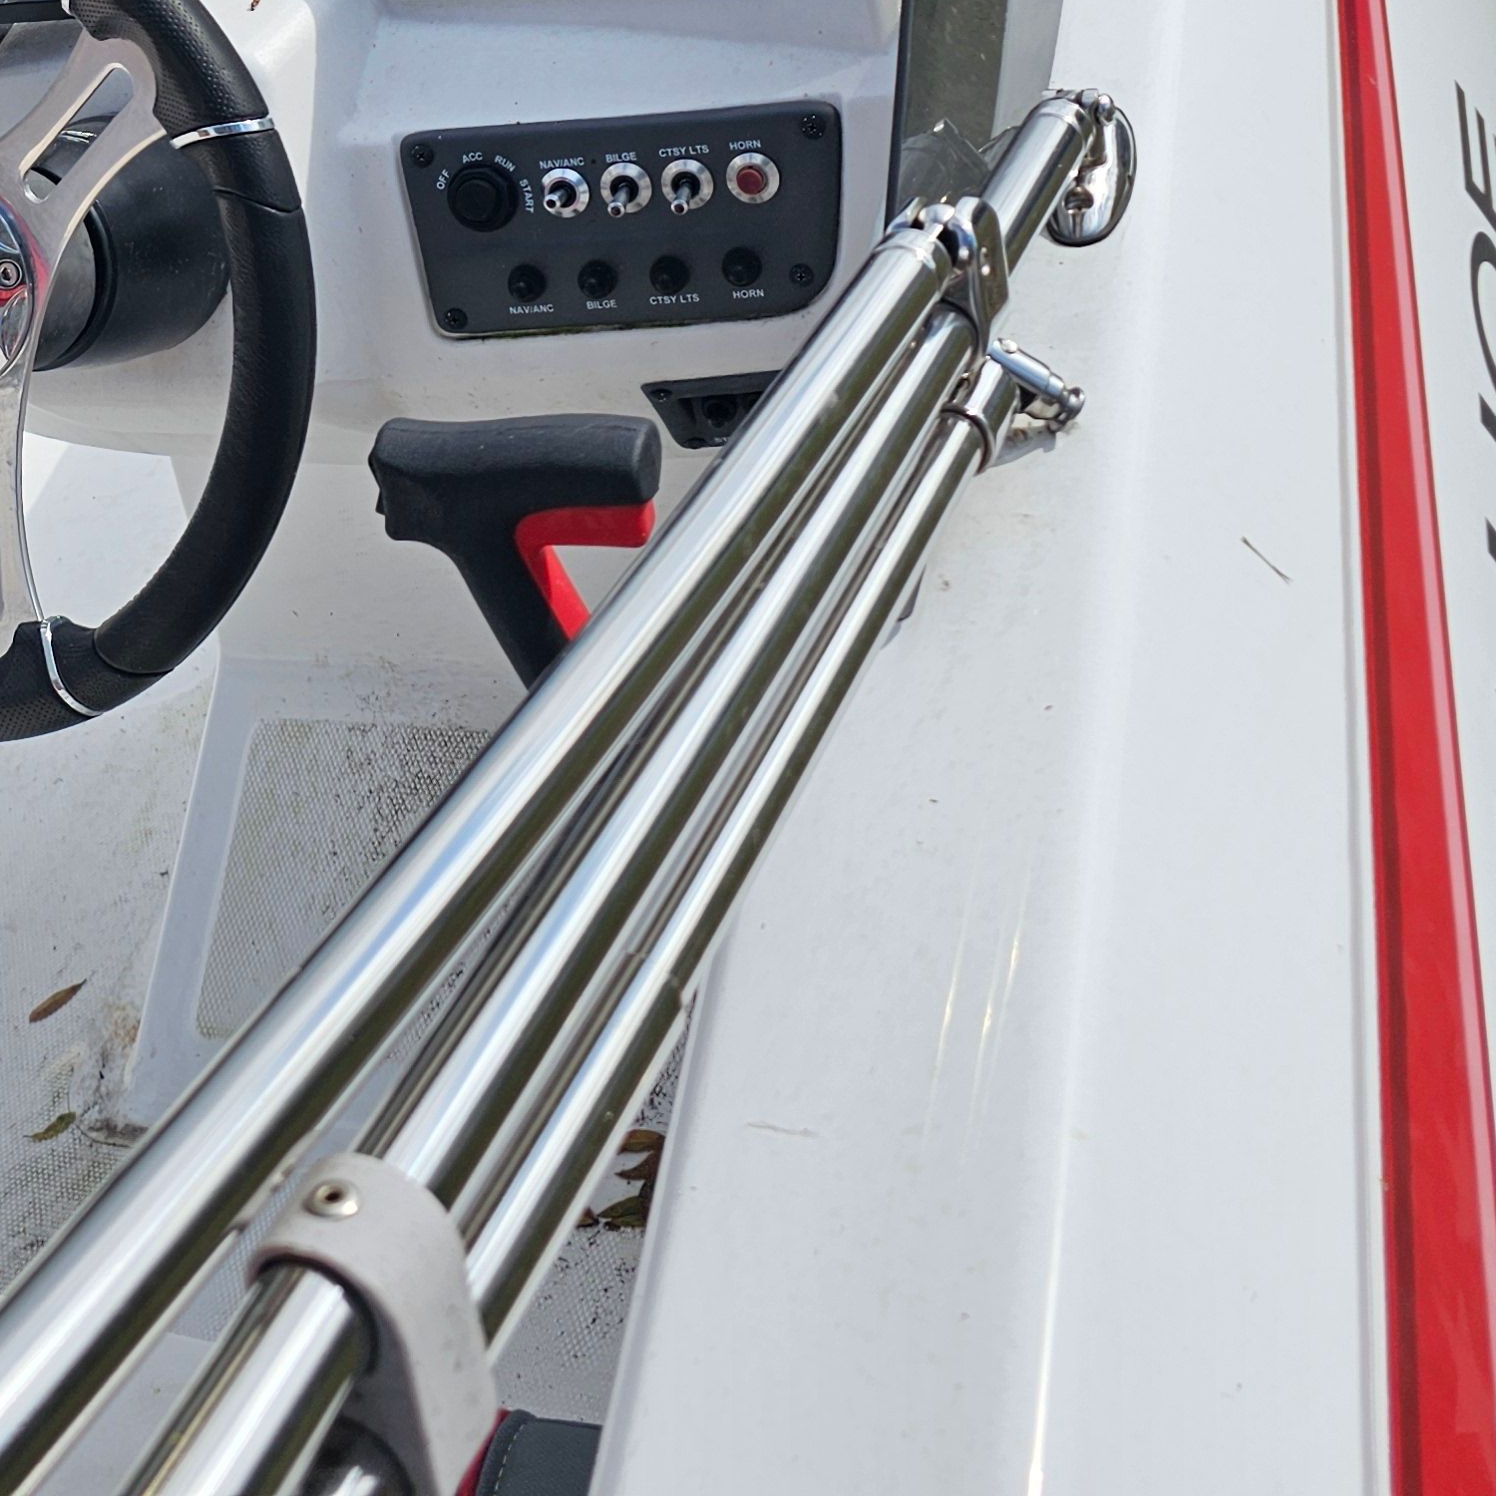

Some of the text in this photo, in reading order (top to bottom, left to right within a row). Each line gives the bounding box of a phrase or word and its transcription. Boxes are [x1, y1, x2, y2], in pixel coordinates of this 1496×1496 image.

[658, 144, 710, 158] CTSY LTS
[729, 139, 761, 151] HORN
[462, 151, 484, 164] ACC
[494, 155, 516, 172] RUN
[539, 156, 585, 170] NAV/ANC
[605, 151, 637, 164] BILGE
[436, 168, 450, 190] OFF
[519, 178, 535, 213] START
[649, 293, 701, 305] CTSY LTS
[732, 288, 764, 300] HORN
[509, 303, 555, 315] NAV/ANC
[586, 299, 618, 310] BILGE
